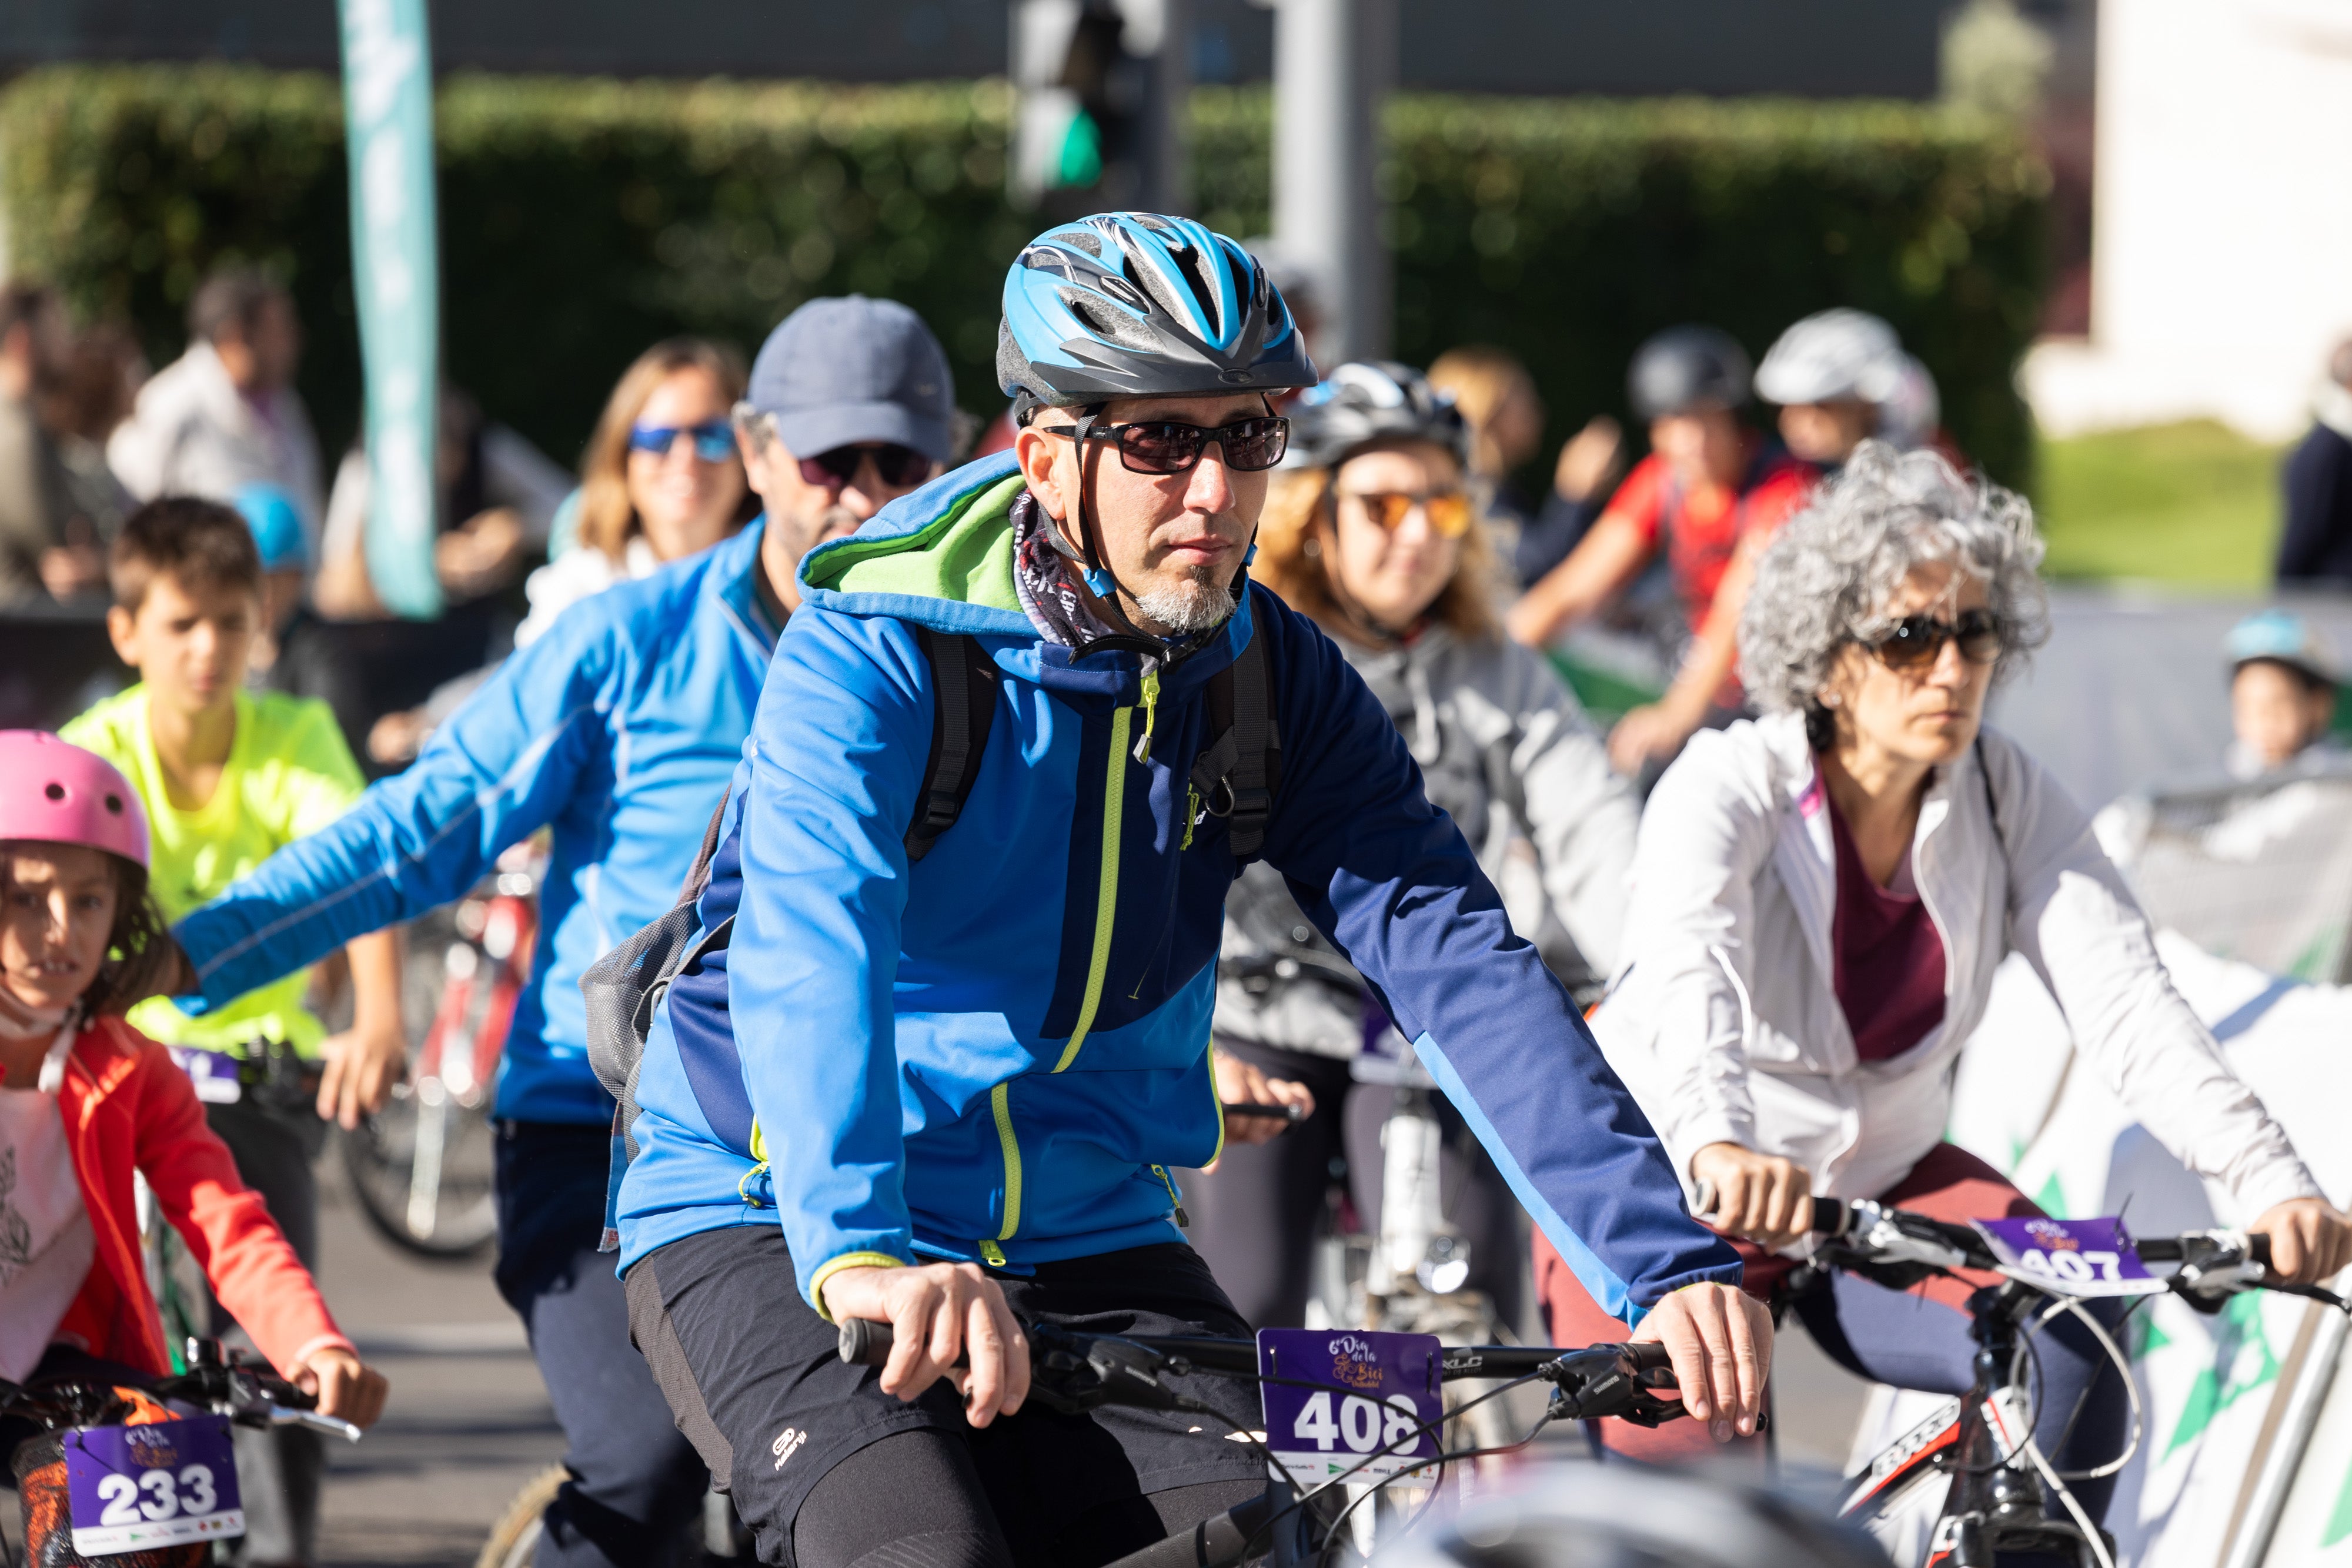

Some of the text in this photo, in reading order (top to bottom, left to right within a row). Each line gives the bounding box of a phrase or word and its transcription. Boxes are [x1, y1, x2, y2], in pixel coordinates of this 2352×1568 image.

[2021, 1249, 2123, 1281] 407
[1357, 1362, 1383, 1381] Bici
[1593, 1375, 1619, 1395] SHIMANO
[1294, 1391, 1419, 1455] 408
[98, 1463, 218, 1527] 233
